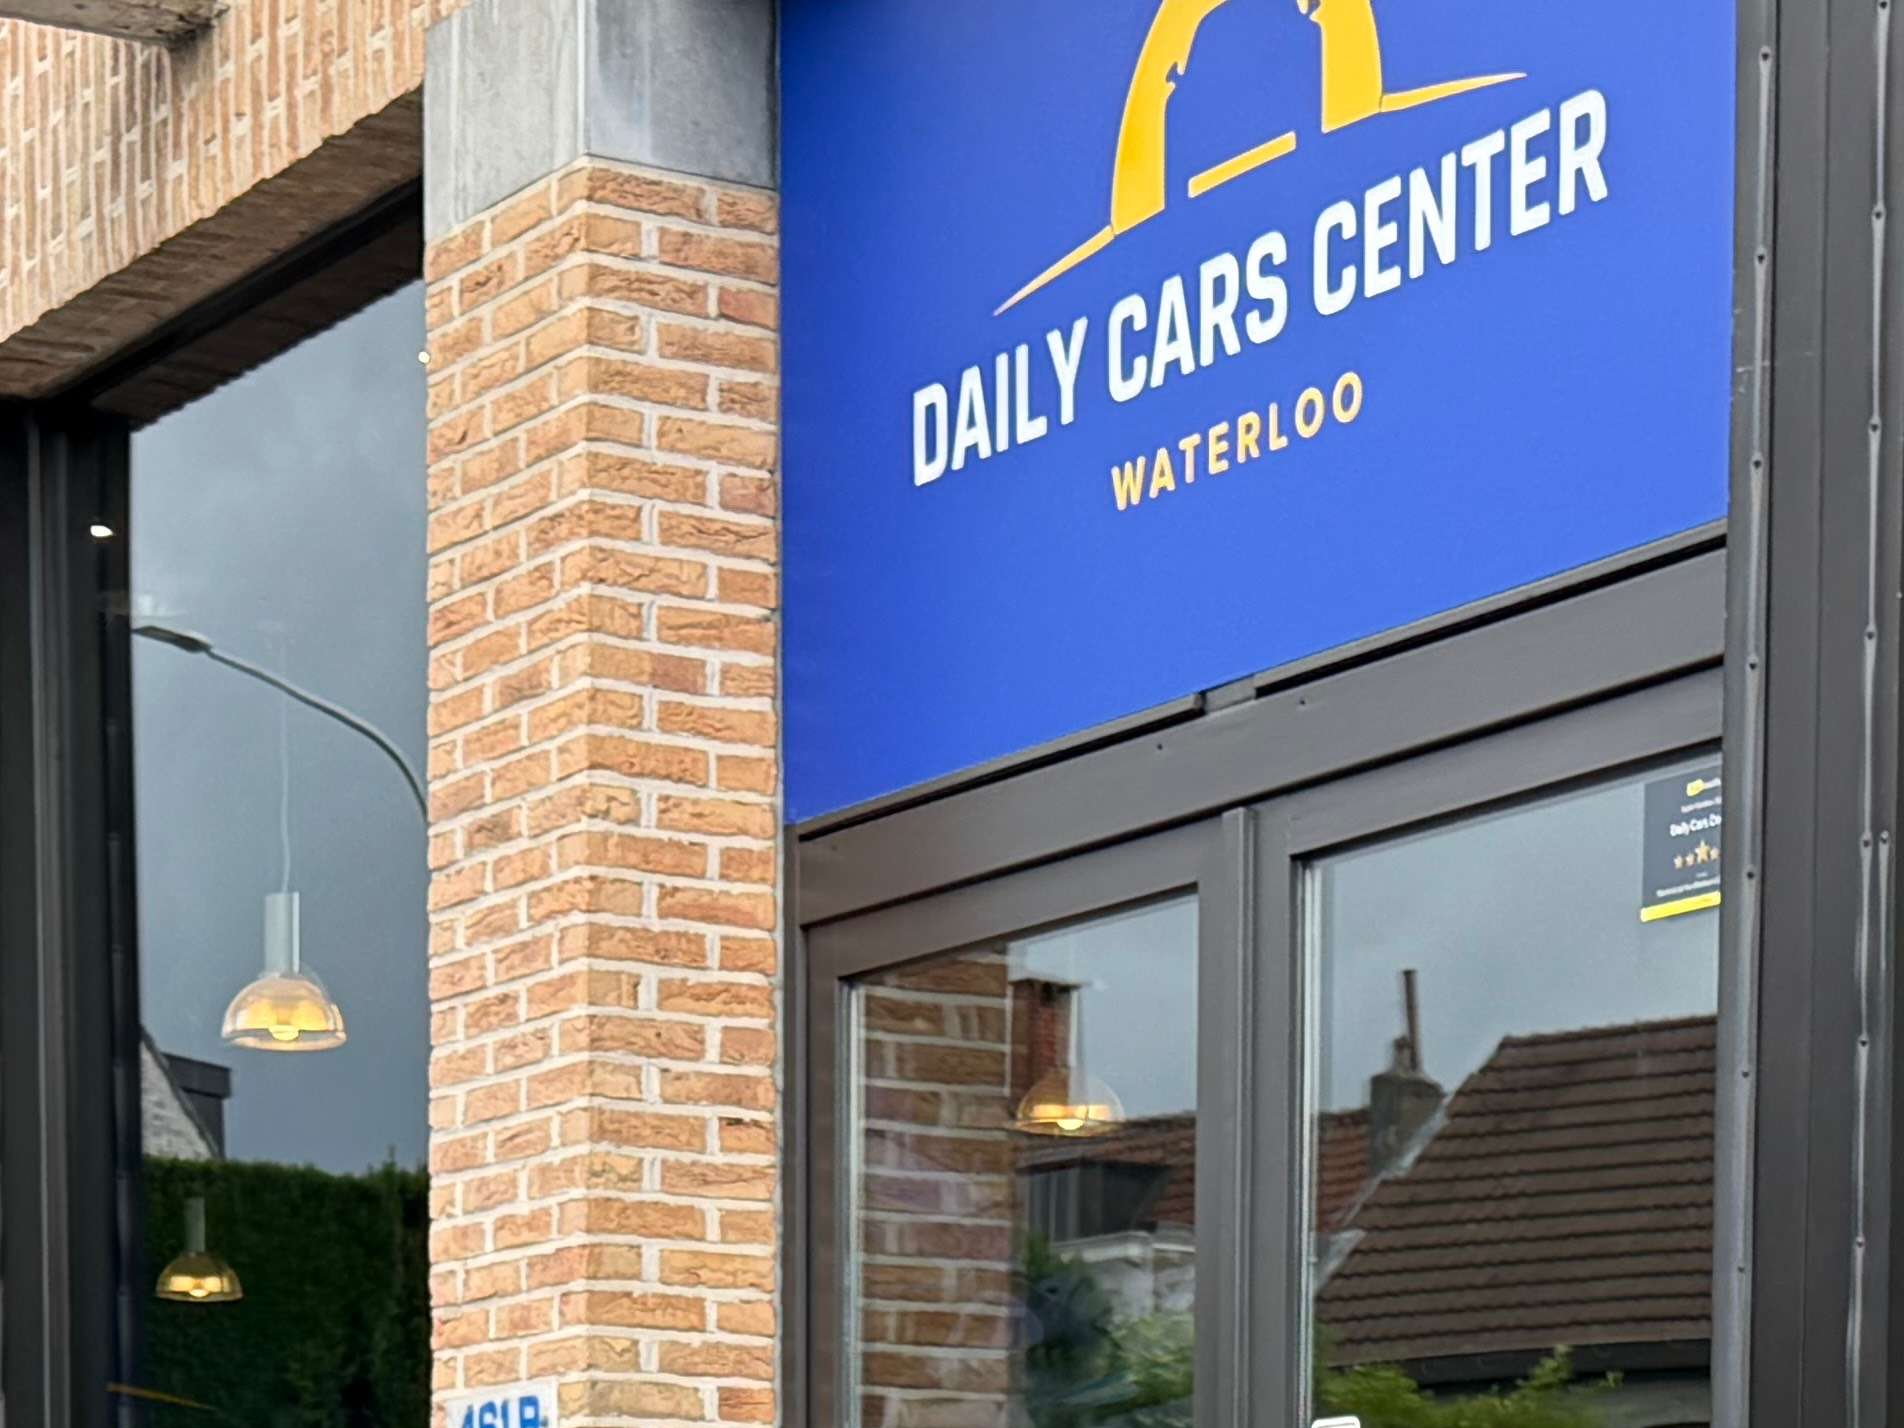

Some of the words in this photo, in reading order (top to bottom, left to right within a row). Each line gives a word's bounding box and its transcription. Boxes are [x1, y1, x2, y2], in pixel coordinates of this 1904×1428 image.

[912, 316, 1089, 487] DAILY
[1107, 230, 1289, 403] CARS
[1312, 88, 1609, 317] CENTER
[1110, 370, 1364, 512] WATERLOO
